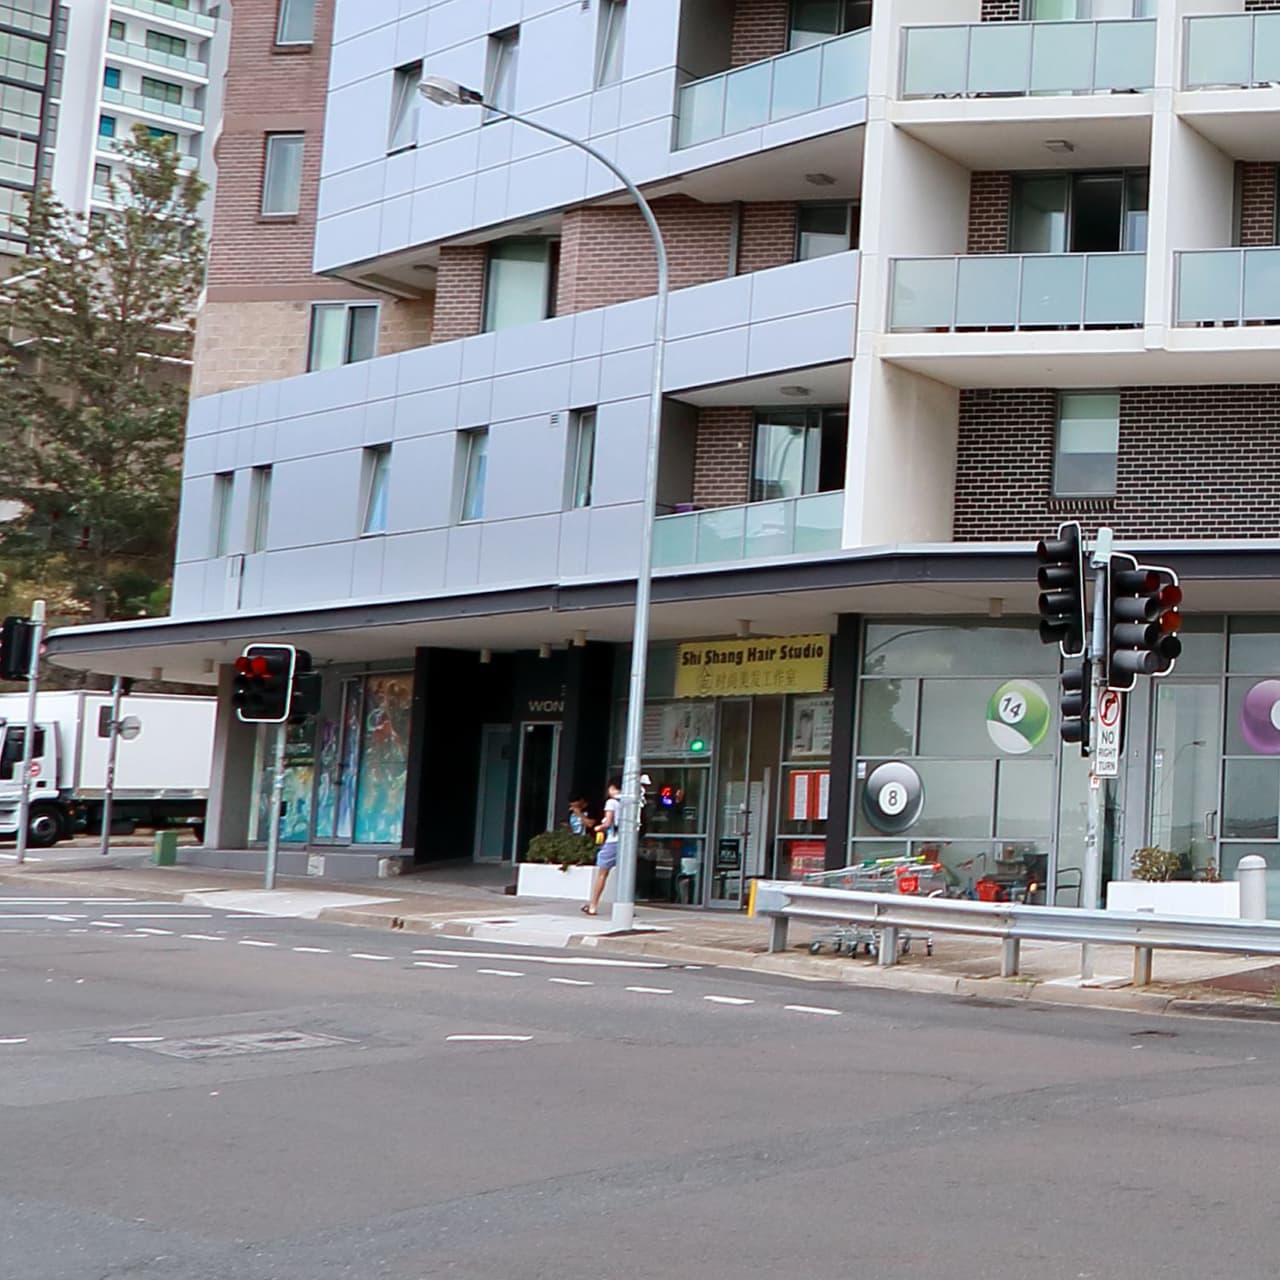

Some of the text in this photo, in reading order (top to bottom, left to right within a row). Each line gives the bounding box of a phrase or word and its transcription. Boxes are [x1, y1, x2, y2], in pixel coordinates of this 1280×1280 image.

[681, 643, 824, 666] Shi Shang Hair Studio
[1003, 697, 1022, 718] 14
[1101, 729, 1115, 745] NO
[1099, 747, 1117, 758] RIGHT
[1099, 761, 1116, 772] TURN
[888, 790, 898, 806] 8
